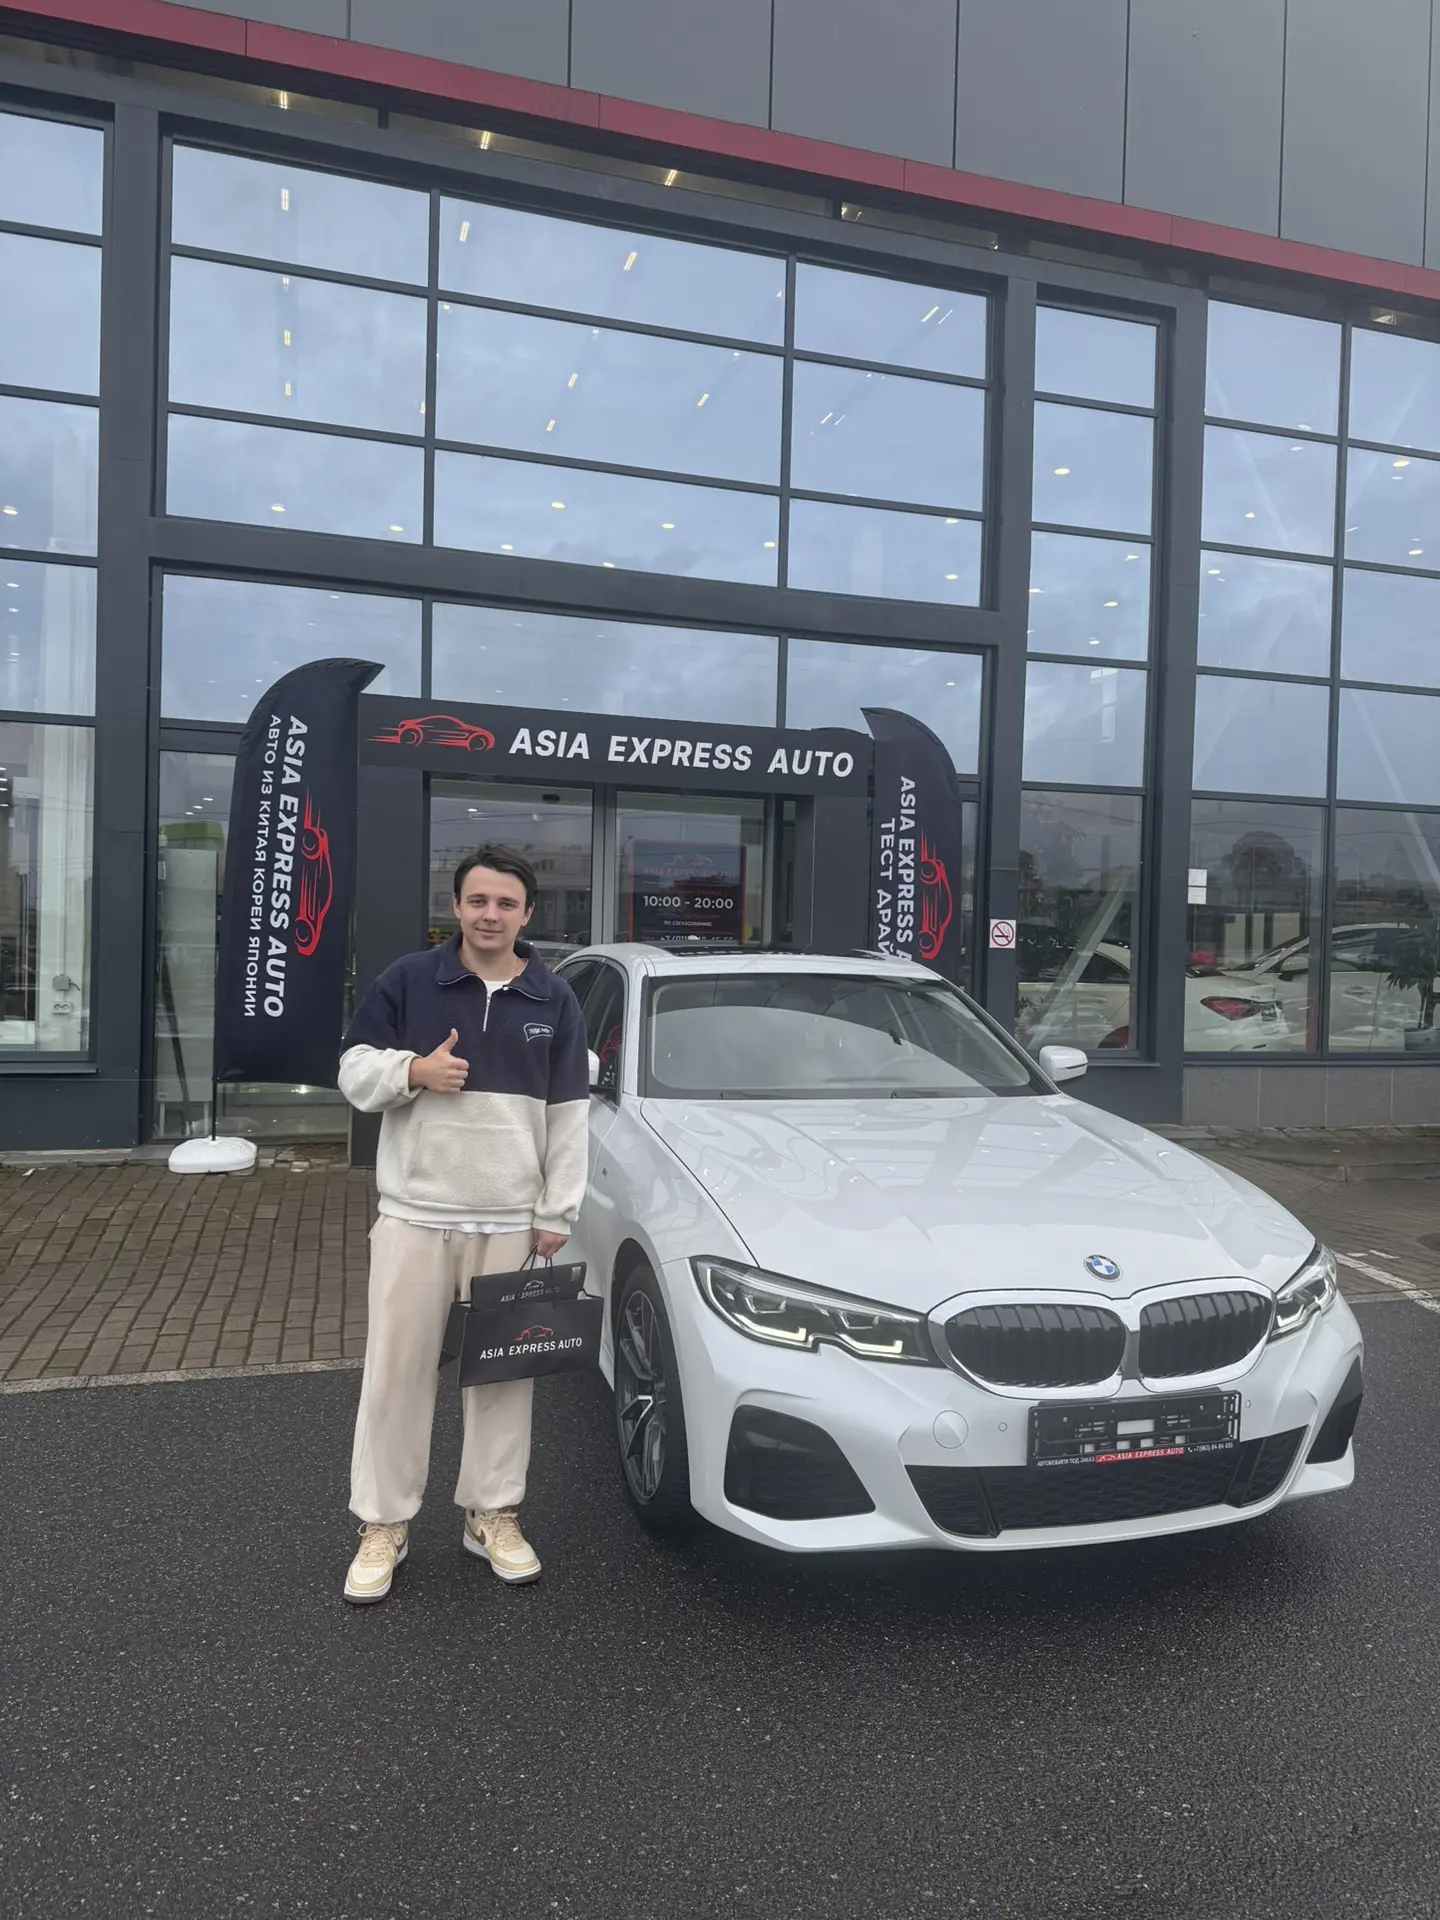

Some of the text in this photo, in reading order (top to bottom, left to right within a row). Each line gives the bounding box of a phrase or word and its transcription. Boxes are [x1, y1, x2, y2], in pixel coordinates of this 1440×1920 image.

[509, 727, 854, 778] ASIA EXPRESS AUTO
[899, 776, 916, 831] ASIA
[244, 714, 281, 1017] АВТО ИЗ КИТАЯ КОРЕИ ЯПОНИИ
[263, 714, 308, 1018] ASIA EXPRESS AUTO
[877, 817, 895, 957] ТЕСТ ДРАЙ
[896, 838, 915, 943] EXPRESS
[643, 895, 681, 908] 10:00
[694, 897, 734, 909] 20:00
[500, 1294, 515, 1303] ASIA
[479, 1337, 583, 1360] ASIA EXPRESS AUTO
[1069, 1457, 1080, 1465] ПОД
[1117, 1447, 1184, 1460] ASIA EXPRESS AUTO
